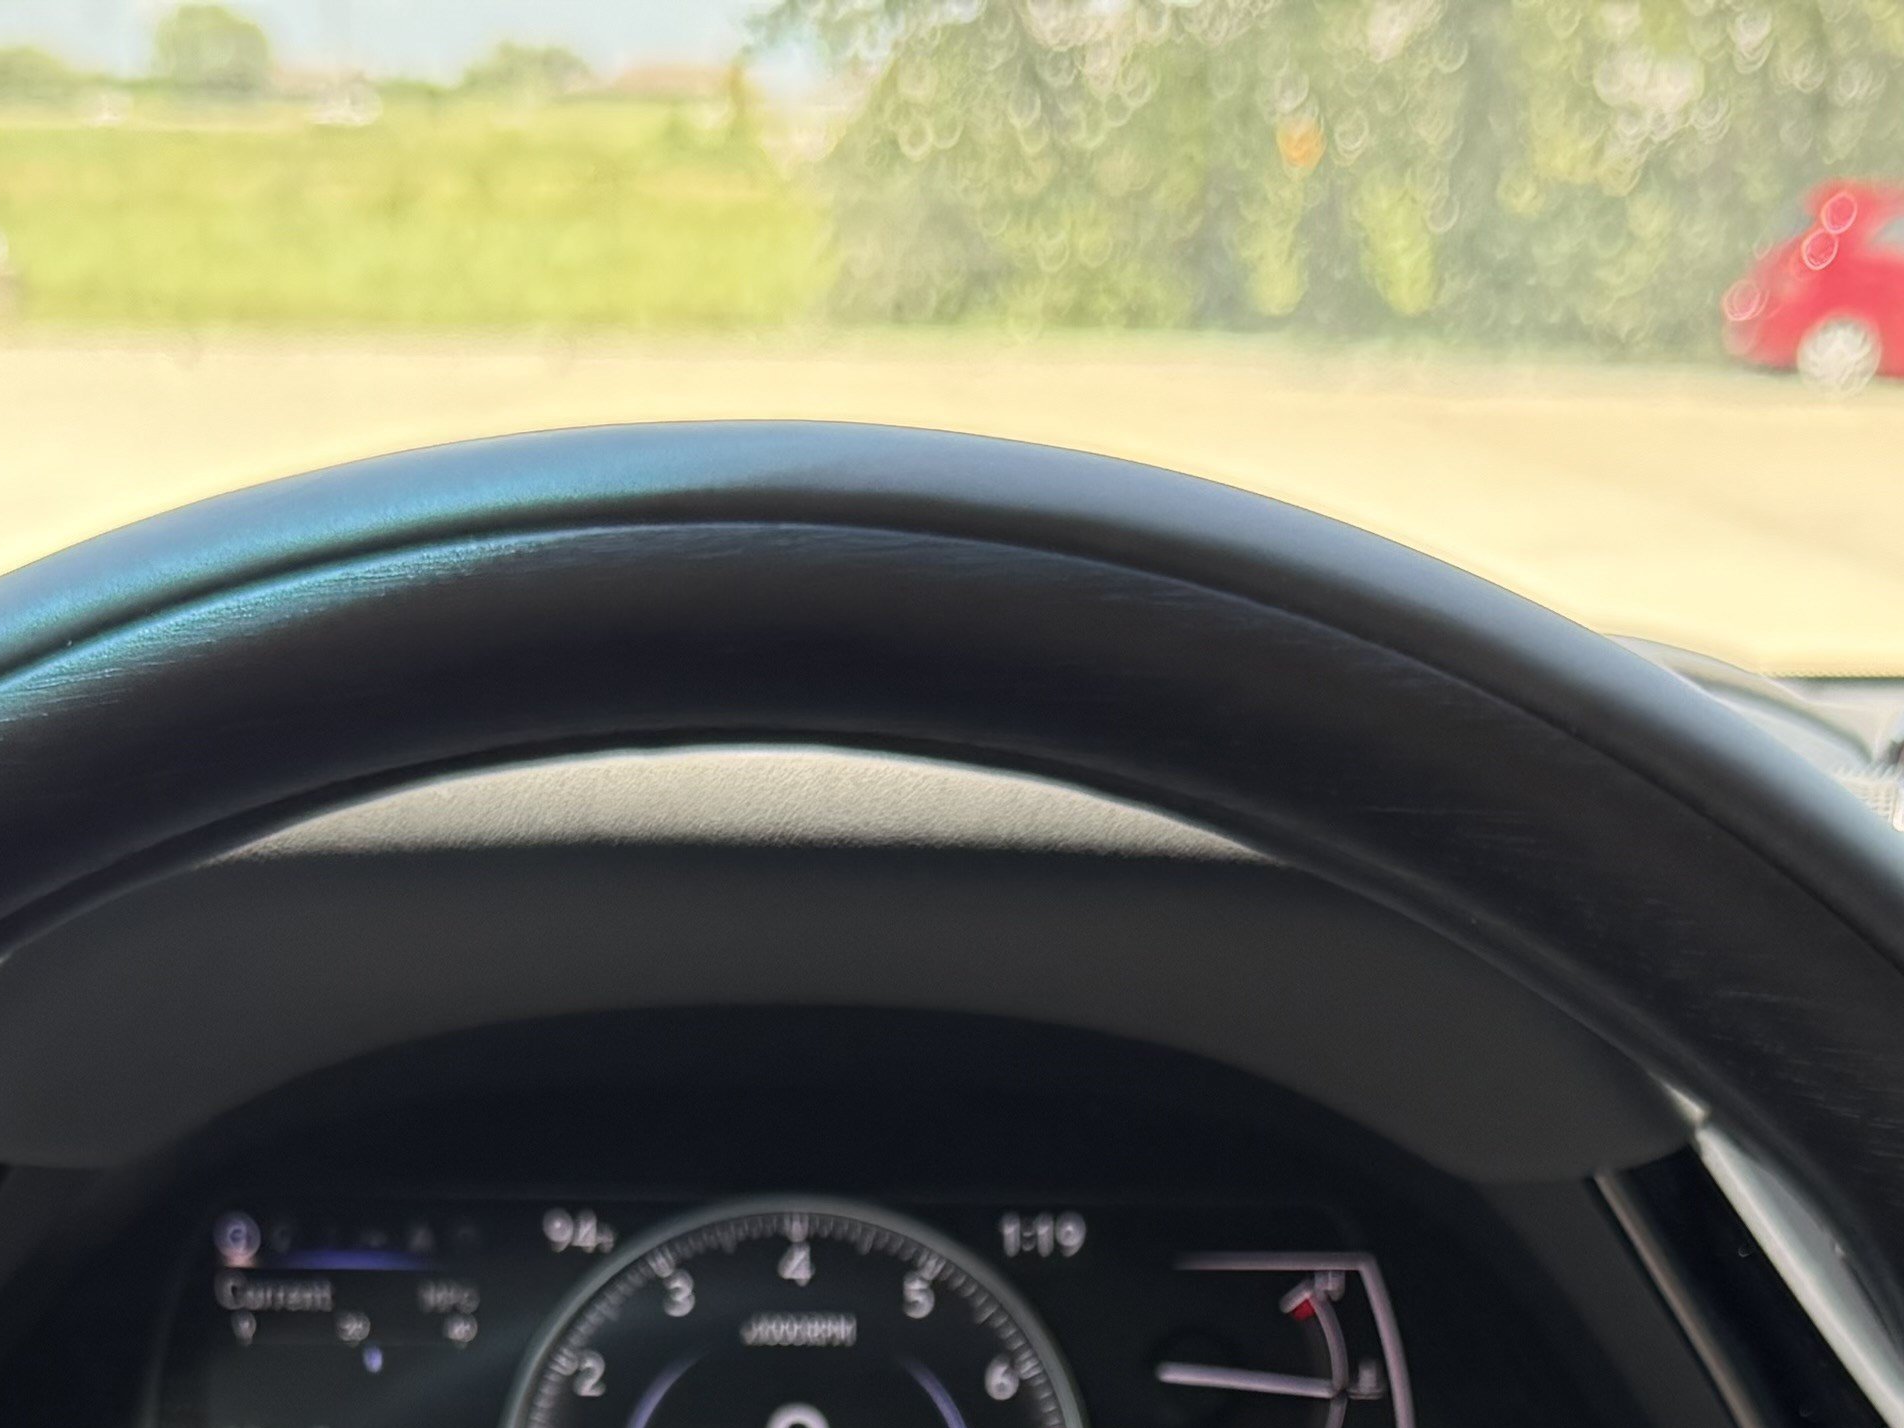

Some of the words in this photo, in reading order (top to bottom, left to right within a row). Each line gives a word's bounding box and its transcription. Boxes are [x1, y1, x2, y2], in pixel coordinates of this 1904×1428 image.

[1000, 1210, 1086, 1257] 1:19
[777, 1242, 815, 1287] 4
[664, 1269, 696, 1317] 3
[903, 1270, 935, 1319] 5
[573, 1350, 606, 1397] 2
[984, 1354, 1019, 1400] 6
